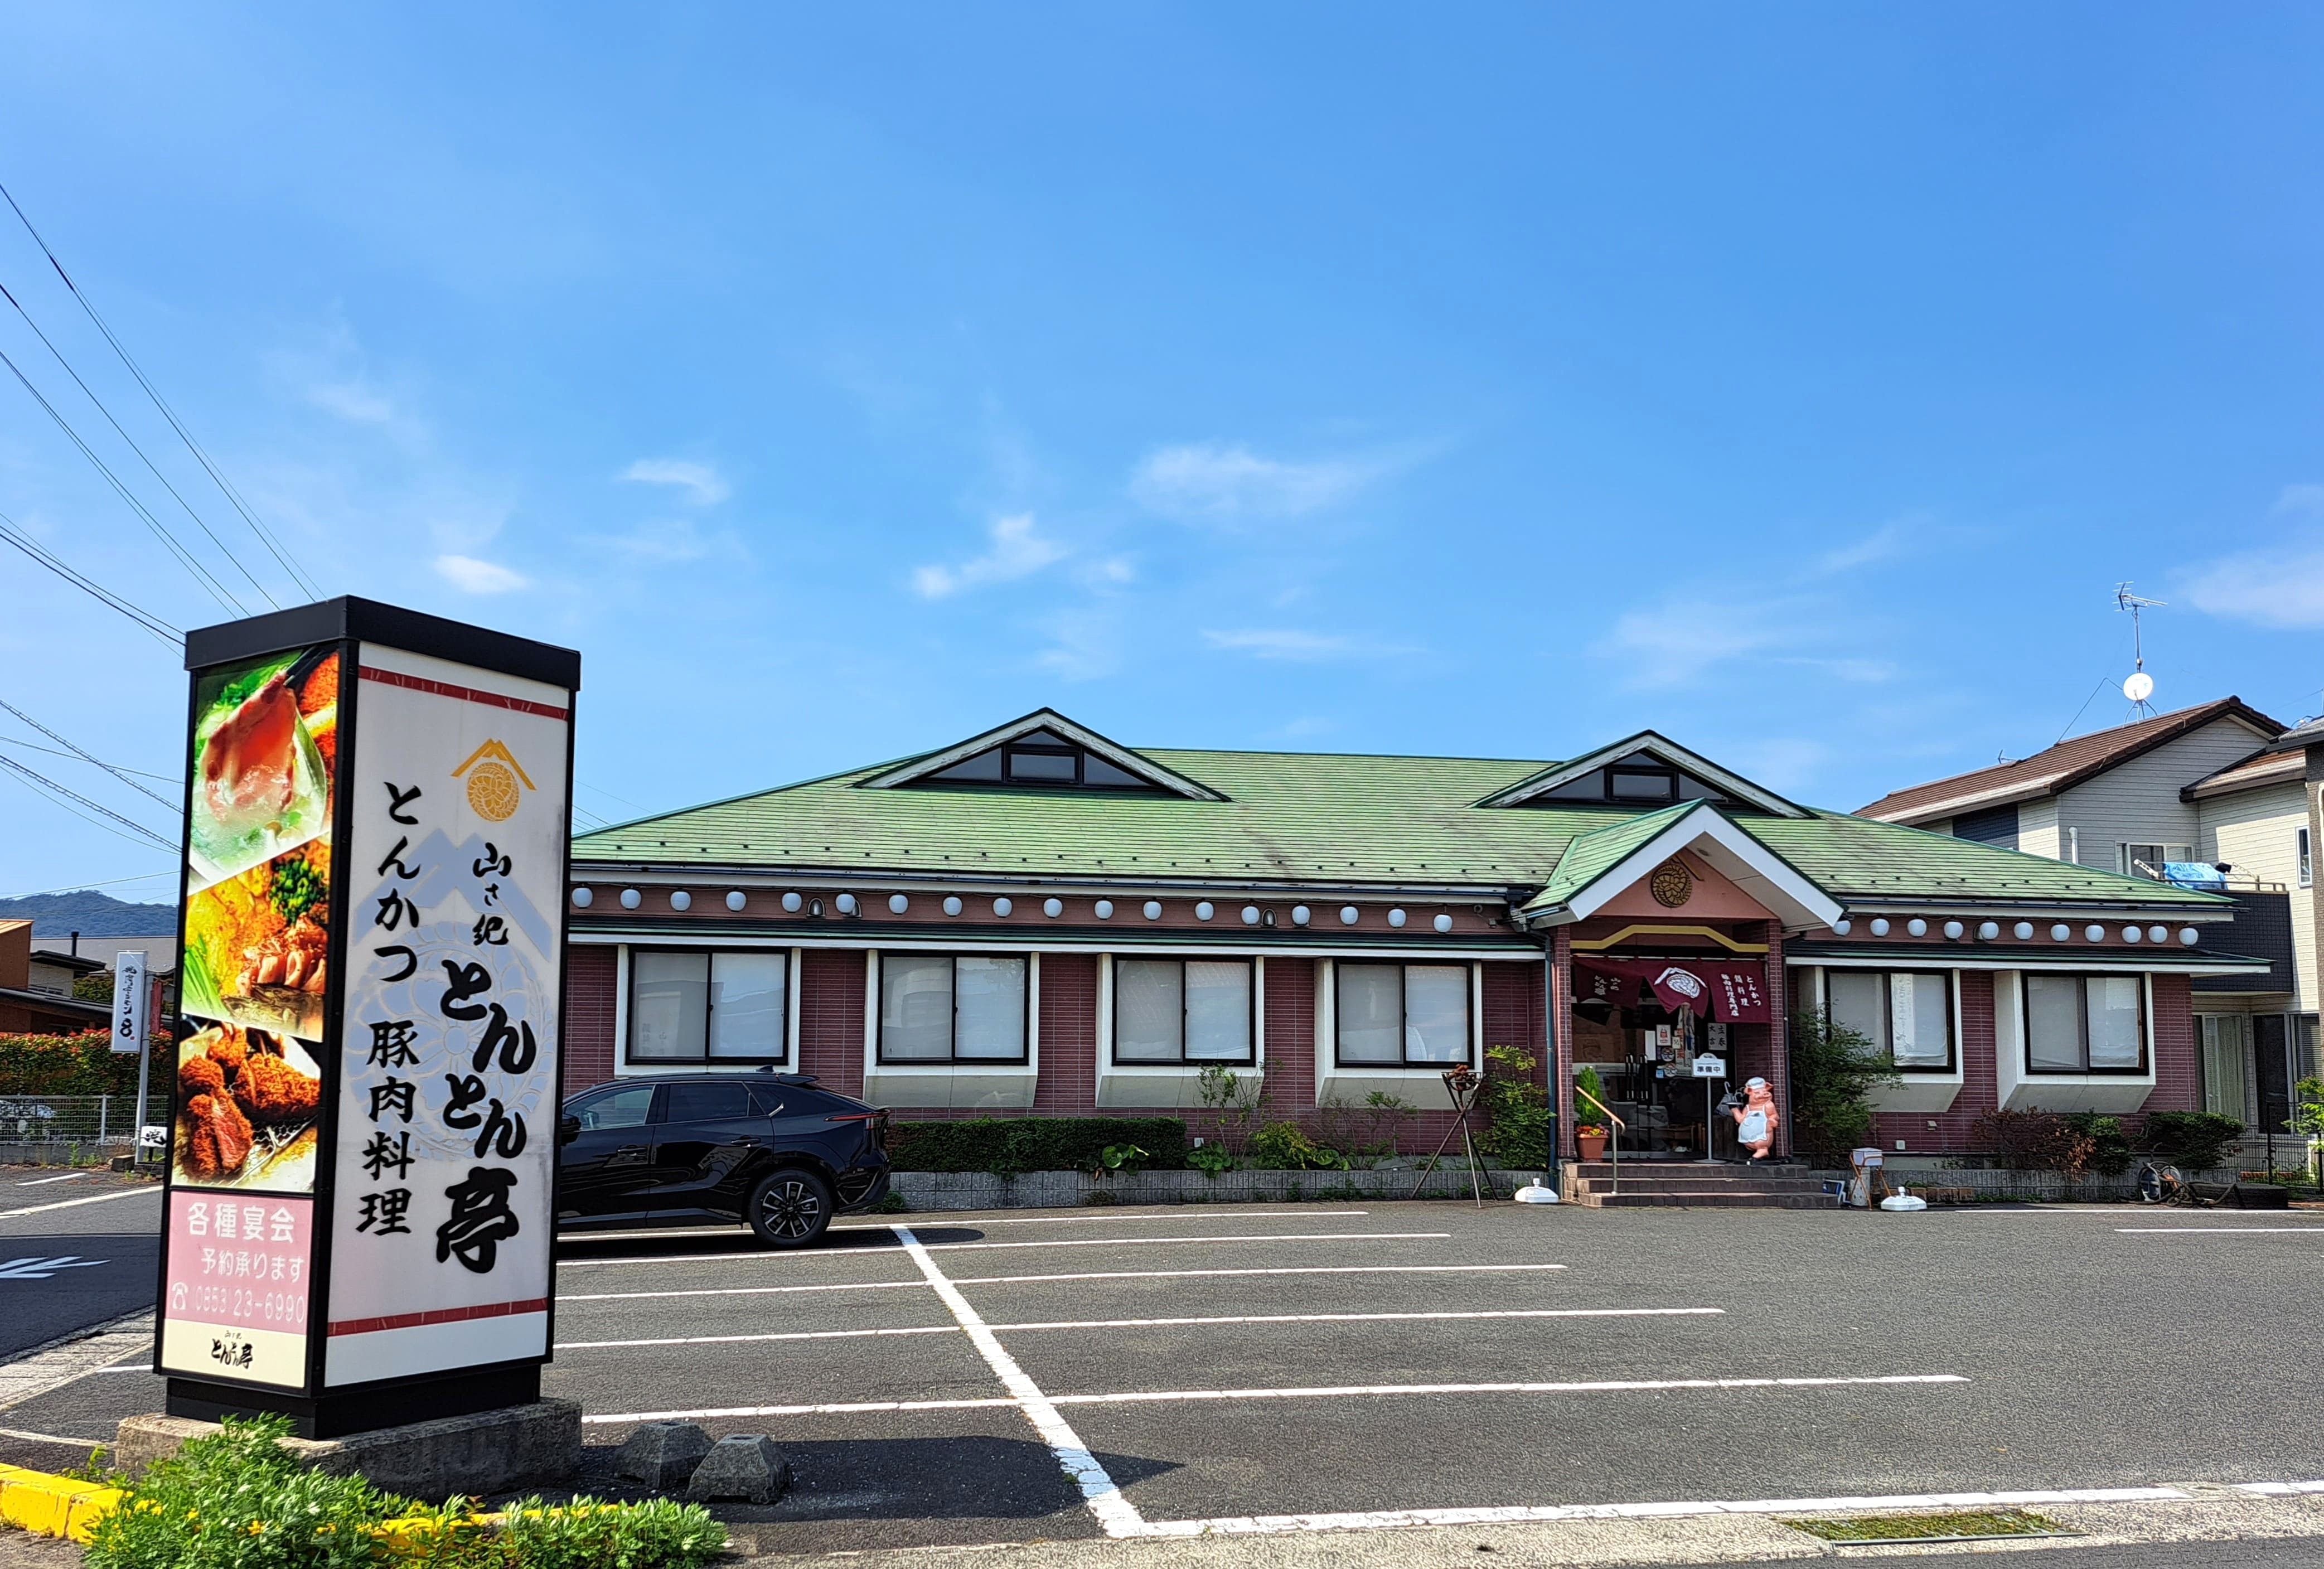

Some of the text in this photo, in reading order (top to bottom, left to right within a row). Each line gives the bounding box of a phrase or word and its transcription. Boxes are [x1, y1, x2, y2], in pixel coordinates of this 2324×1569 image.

[472, 842, 512, 946] 山さ紀
[355, 781, 422, 1236] とんかつ 豚肉料理
[1746, 975, 1761, 1006] とんかつ
[435, 958, 537, 1274] とんとん亭
[187, 1202, 295, 1243] 各種宴会
[201, 1247, 304, 1283] 予約承ります
